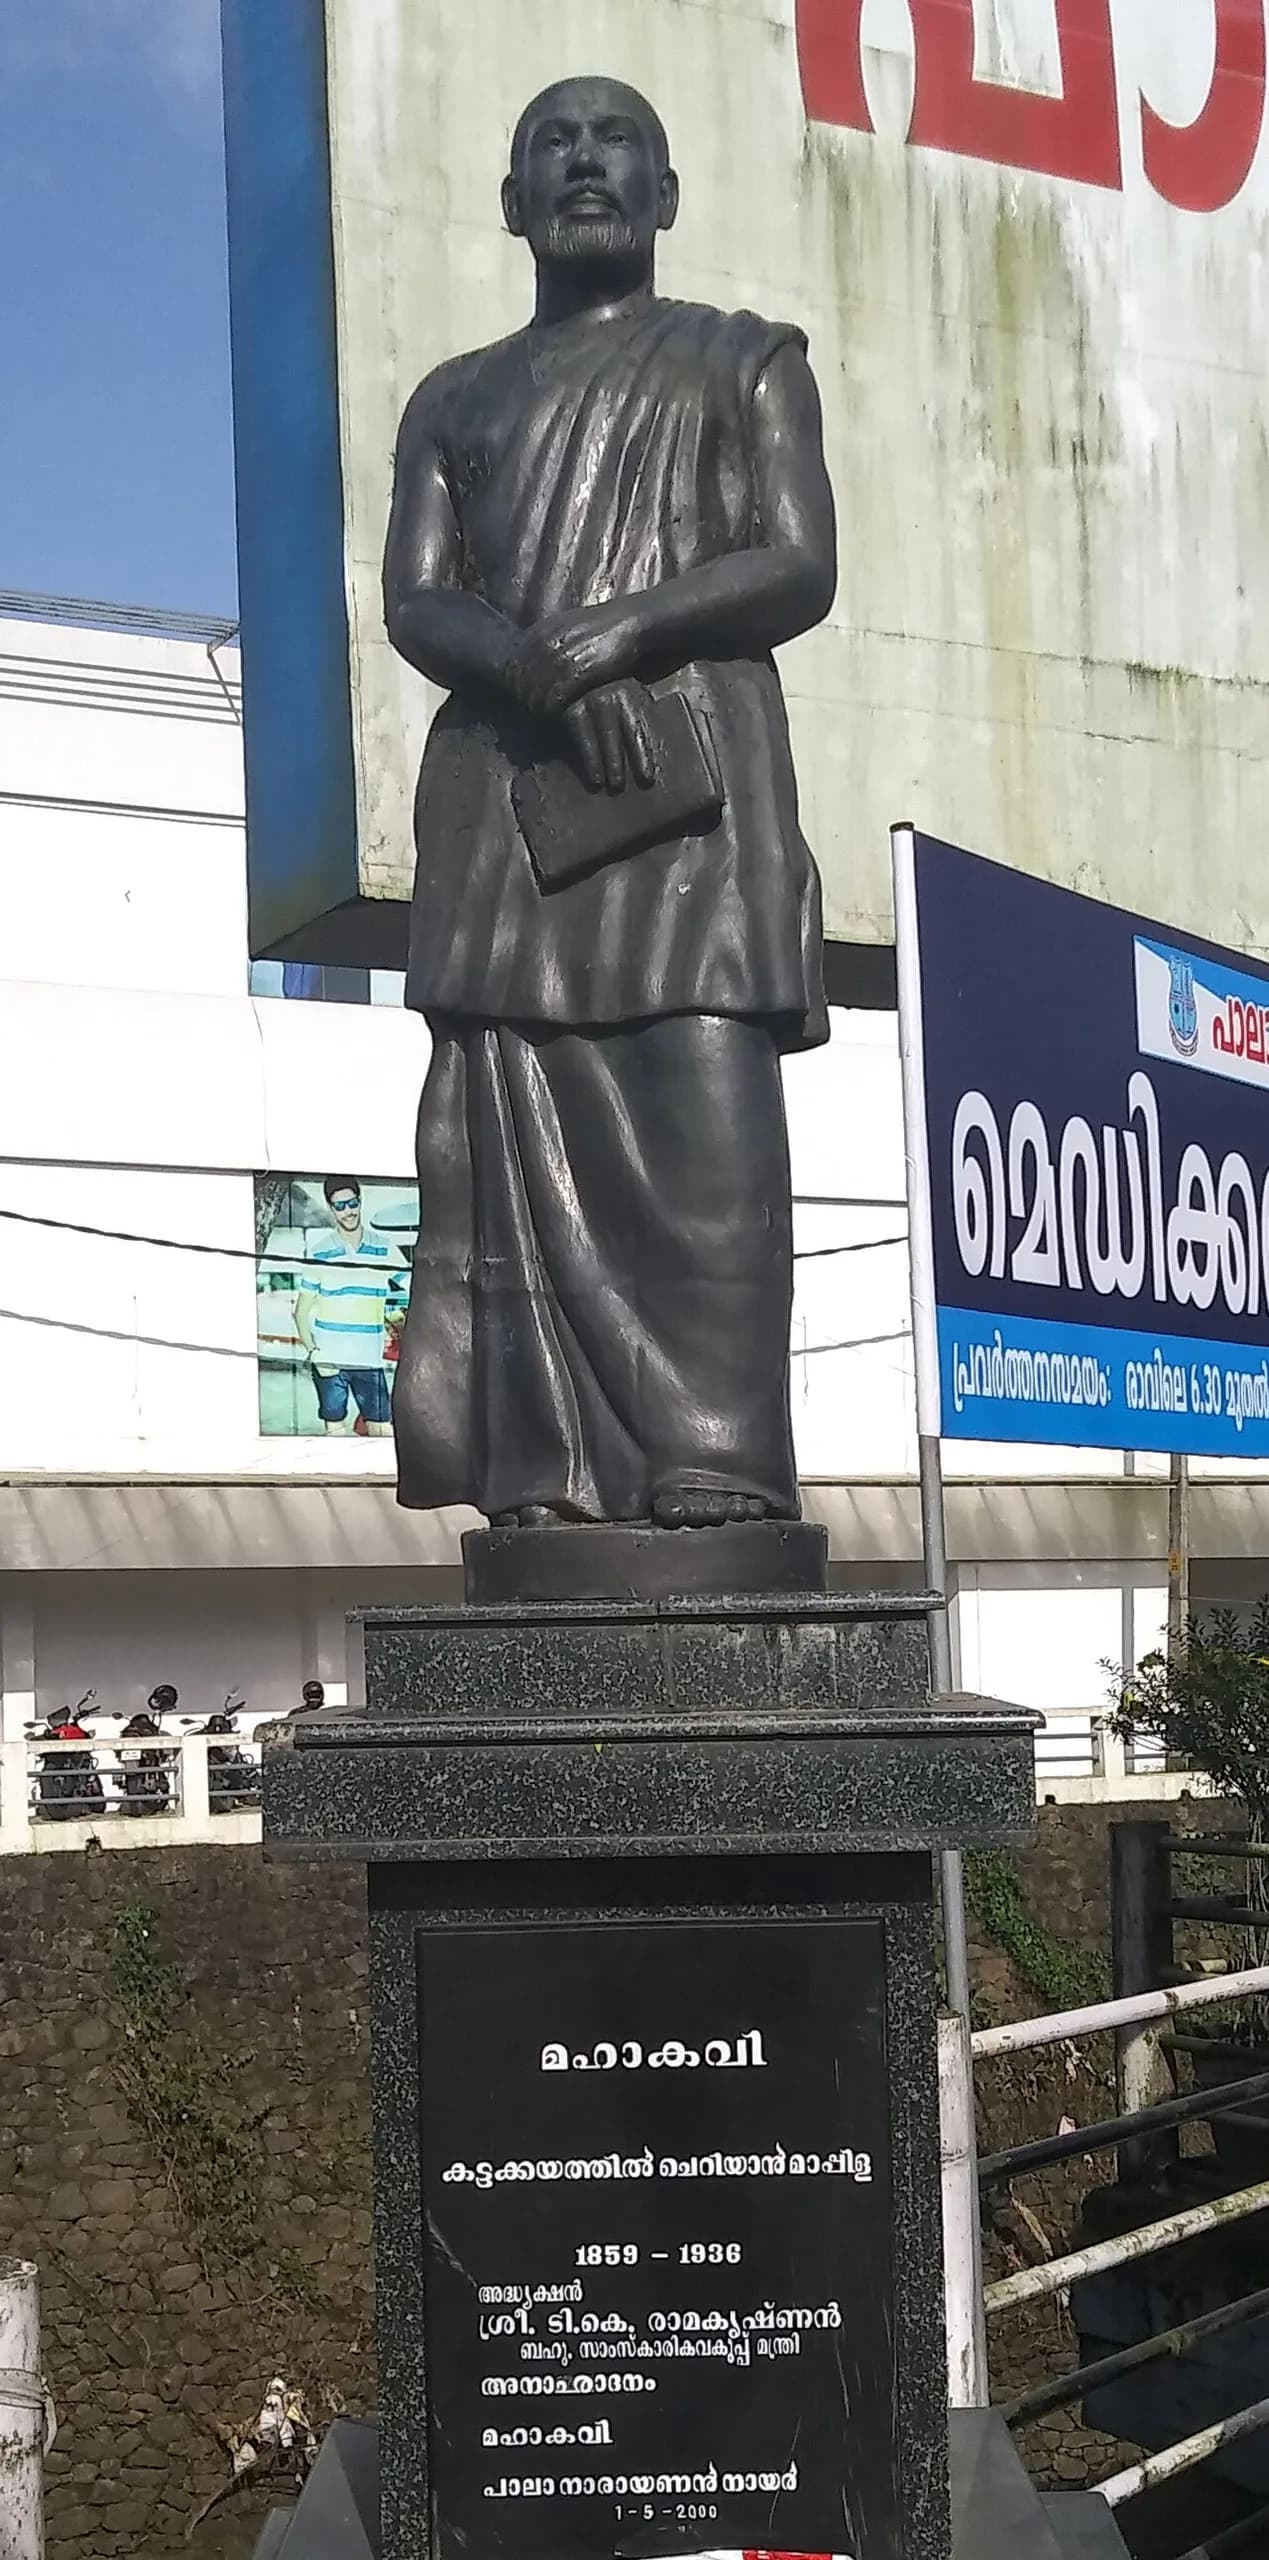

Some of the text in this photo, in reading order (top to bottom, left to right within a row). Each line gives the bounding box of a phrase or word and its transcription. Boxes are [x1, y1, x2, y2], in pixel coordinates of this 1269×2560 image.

[952, 1071, 1269, 1317] മെഡിക്ക
[1125, 1348, 1188, 1412] രാവിലെ
[1190, 1363, 1222, 1416] 6.30
[540, 2029, 768, 2072] മഹാകവി
[575, 2244, 638, 2266] 1859
[679, 2243, 741, 2265] 1936
[482, 2419, 613, 2447] മഹാകവി
[483, 2477, 555, 2497] പാലാ
